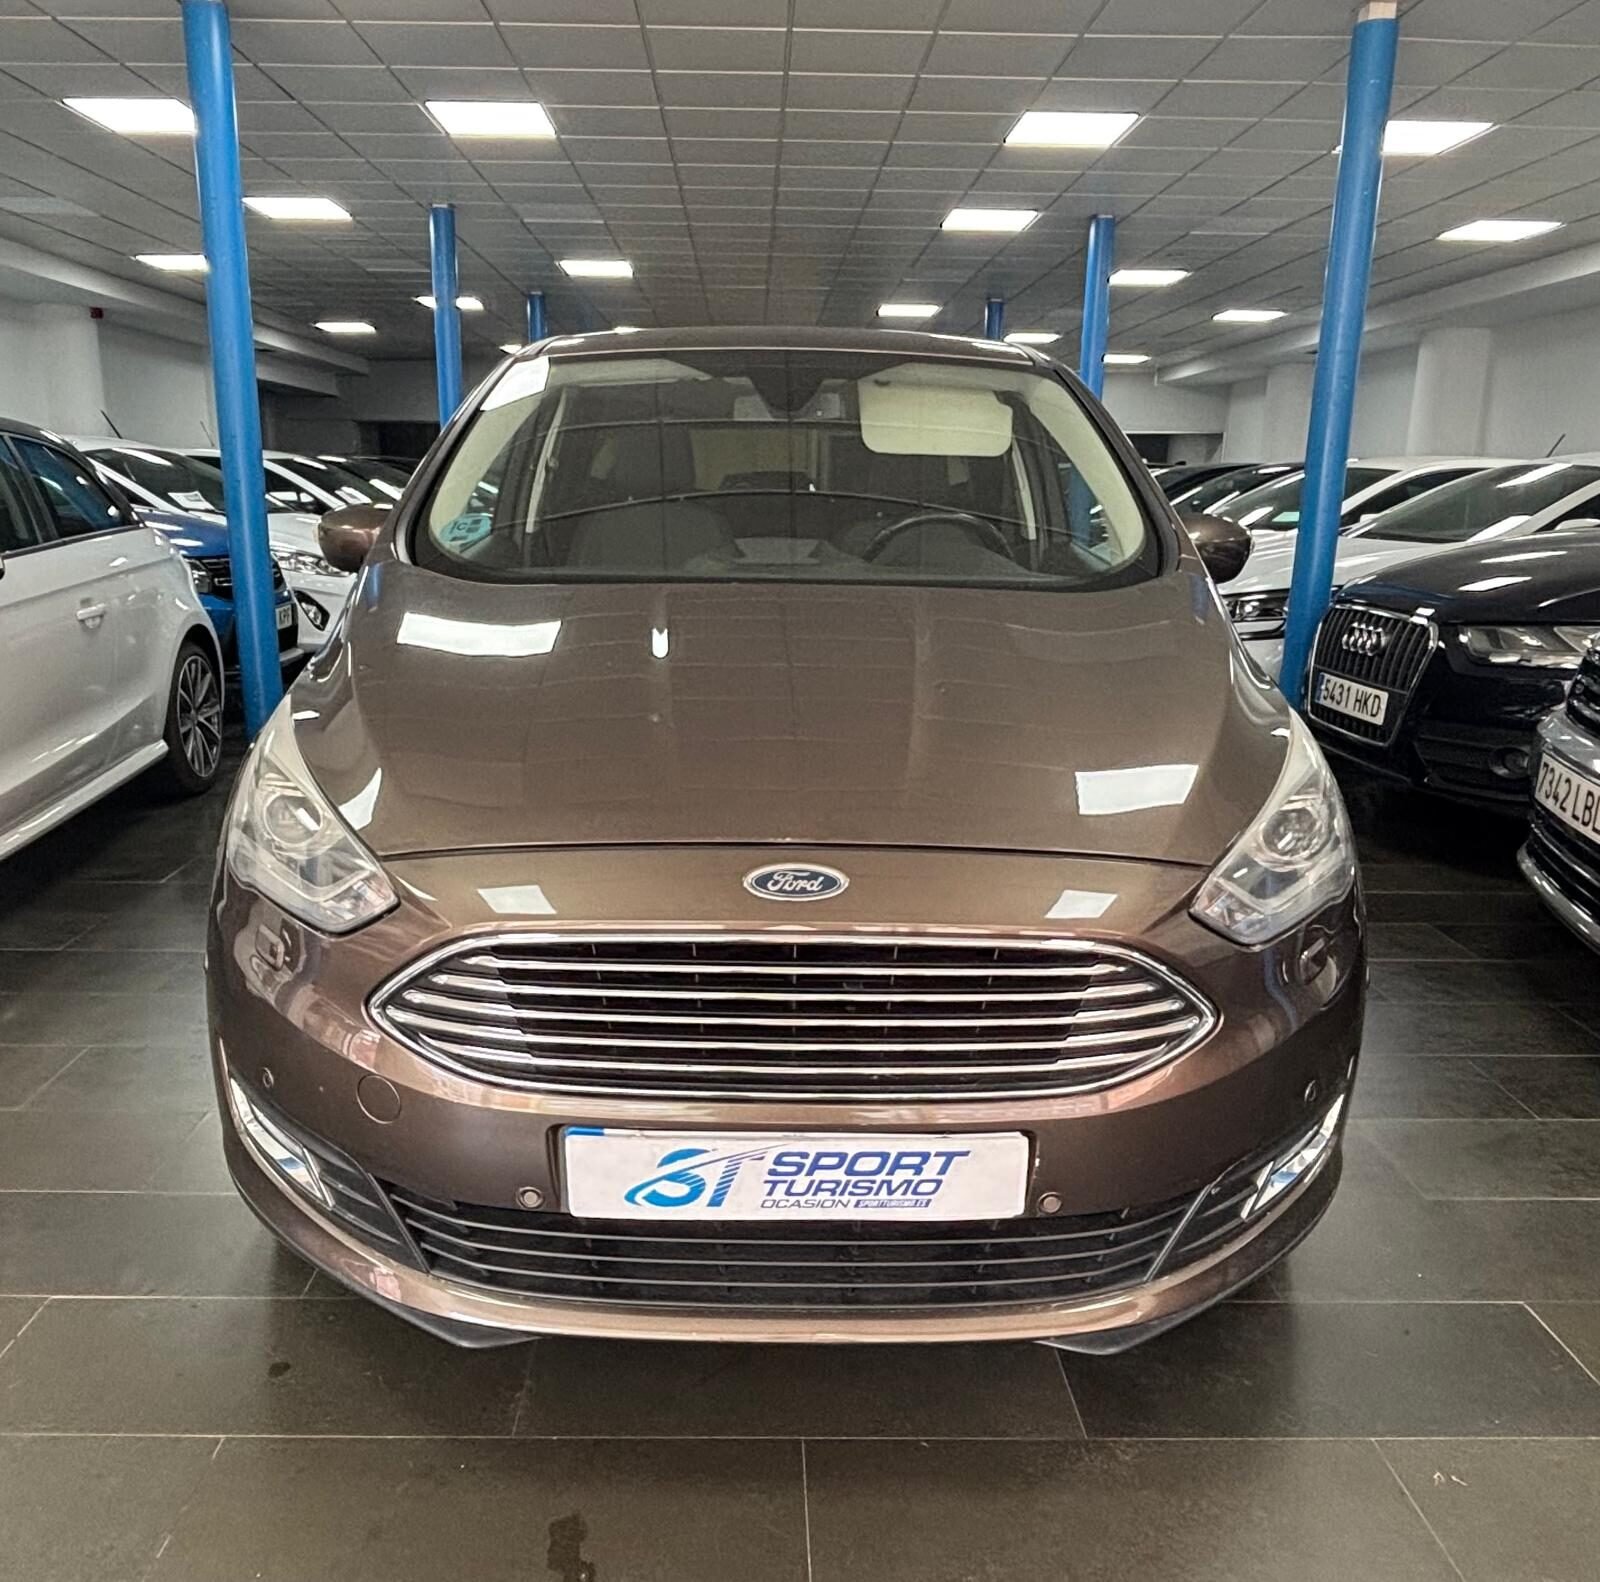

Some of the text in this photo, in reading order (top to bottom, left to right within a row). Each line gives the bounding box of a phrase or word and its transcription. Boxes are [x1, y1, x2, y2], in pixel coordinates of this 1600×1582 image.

[1323, 679, 1381, 718] 5431 HKD
[1538, 761, 1572, 814] 7342
[767, 870, 824, 891] Ford
[767, 1150, 970, 1177] SPORT
[763, 1178, 944, 1197] TURISMO
[760, 1199, 851, 1209] OCASION
